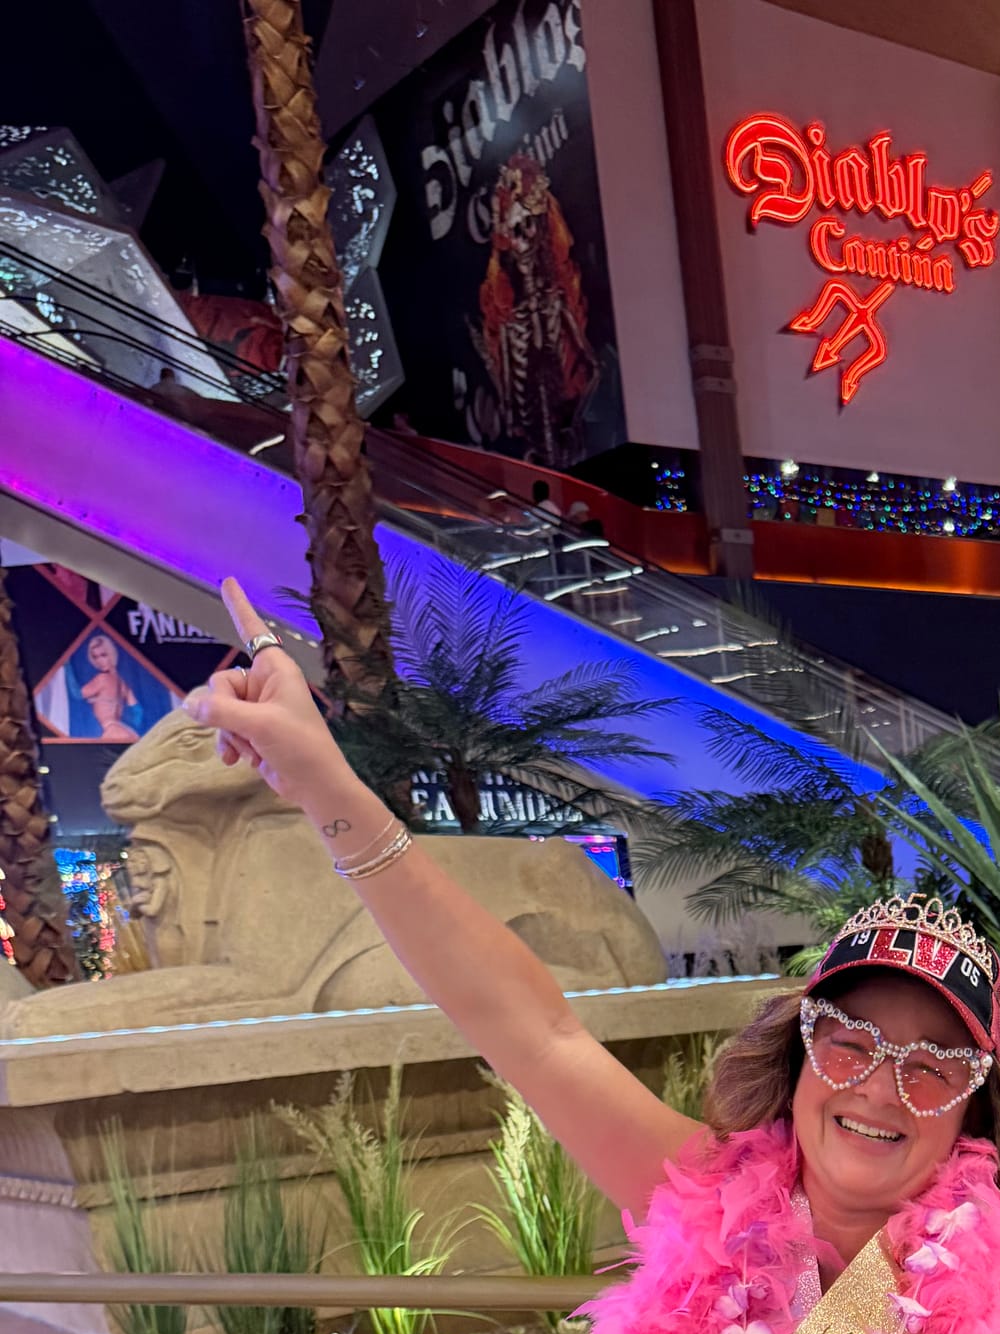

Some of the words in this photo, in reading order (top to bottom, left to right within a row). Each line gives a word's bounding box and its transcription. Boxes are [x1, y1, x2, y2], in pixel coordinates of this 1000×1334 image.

[726, 114, 999, 268] Diablo's
[866, 927, 961, 980] LV
[960, 957, 981, 988] 05
